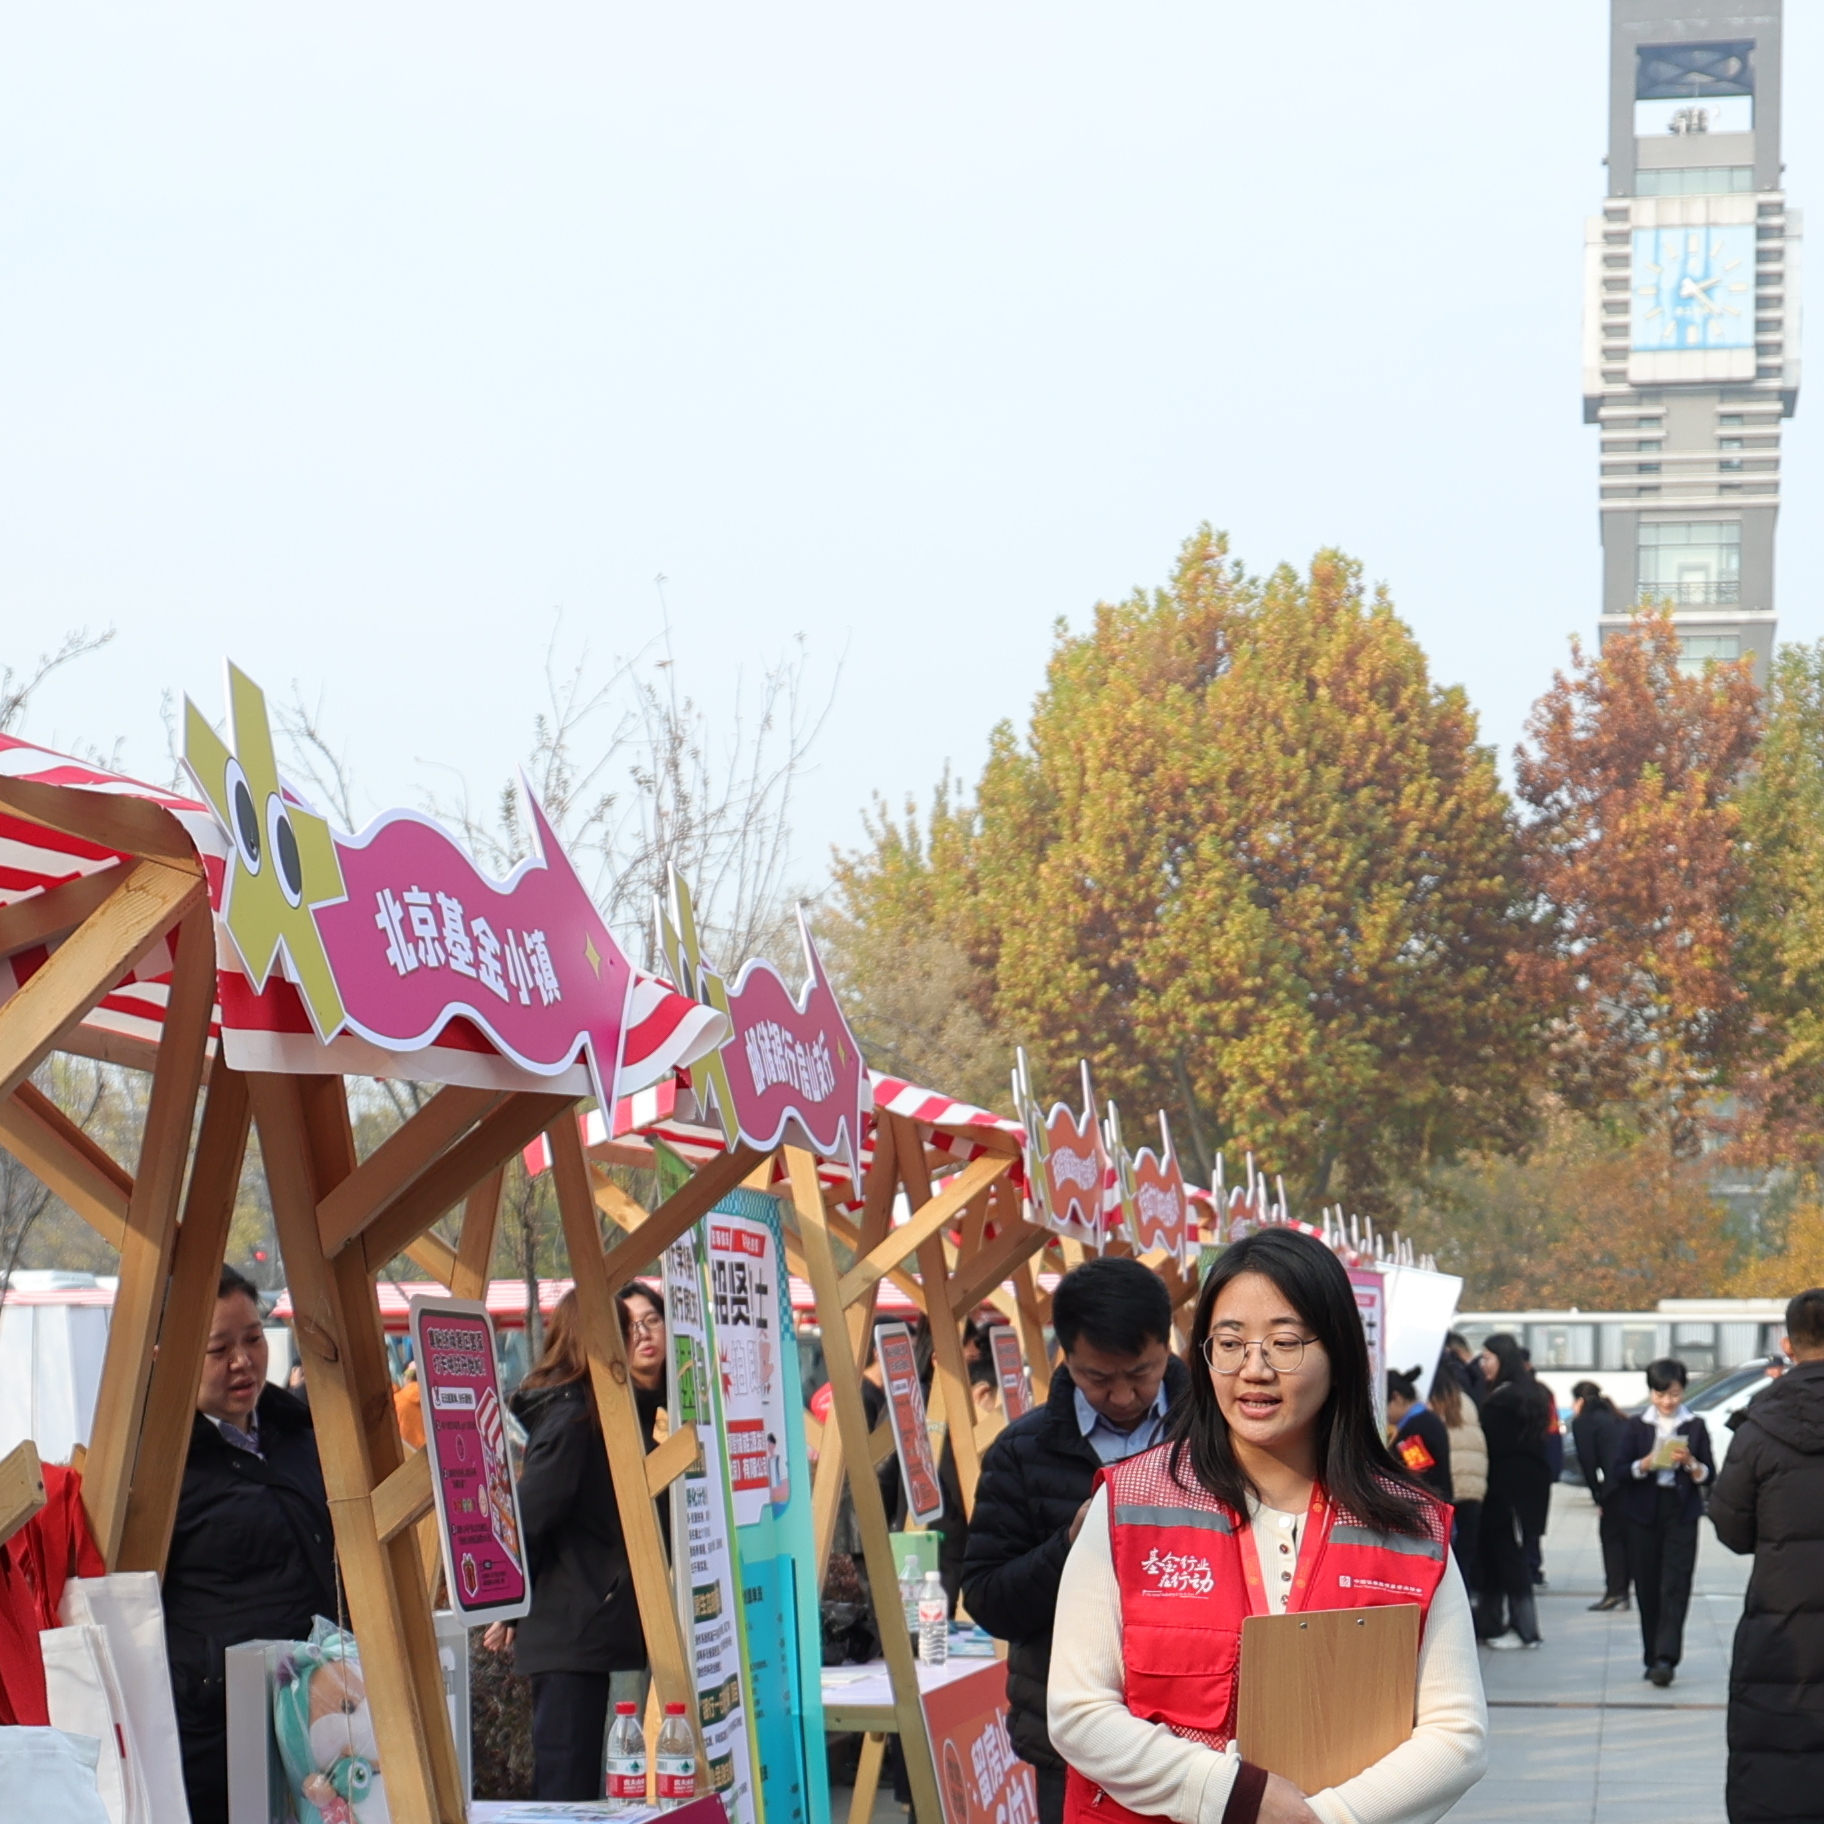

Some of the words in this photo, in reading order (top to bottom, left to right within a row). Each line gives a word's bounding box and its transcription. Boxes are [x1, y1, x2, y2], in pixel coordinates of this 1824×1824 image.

[375, 884, 563, 1008] 北京基金小镇
[1141, 1547, 1210, 1575] 基金行业
[1157, 1572, 1215, 1595] 在行动
